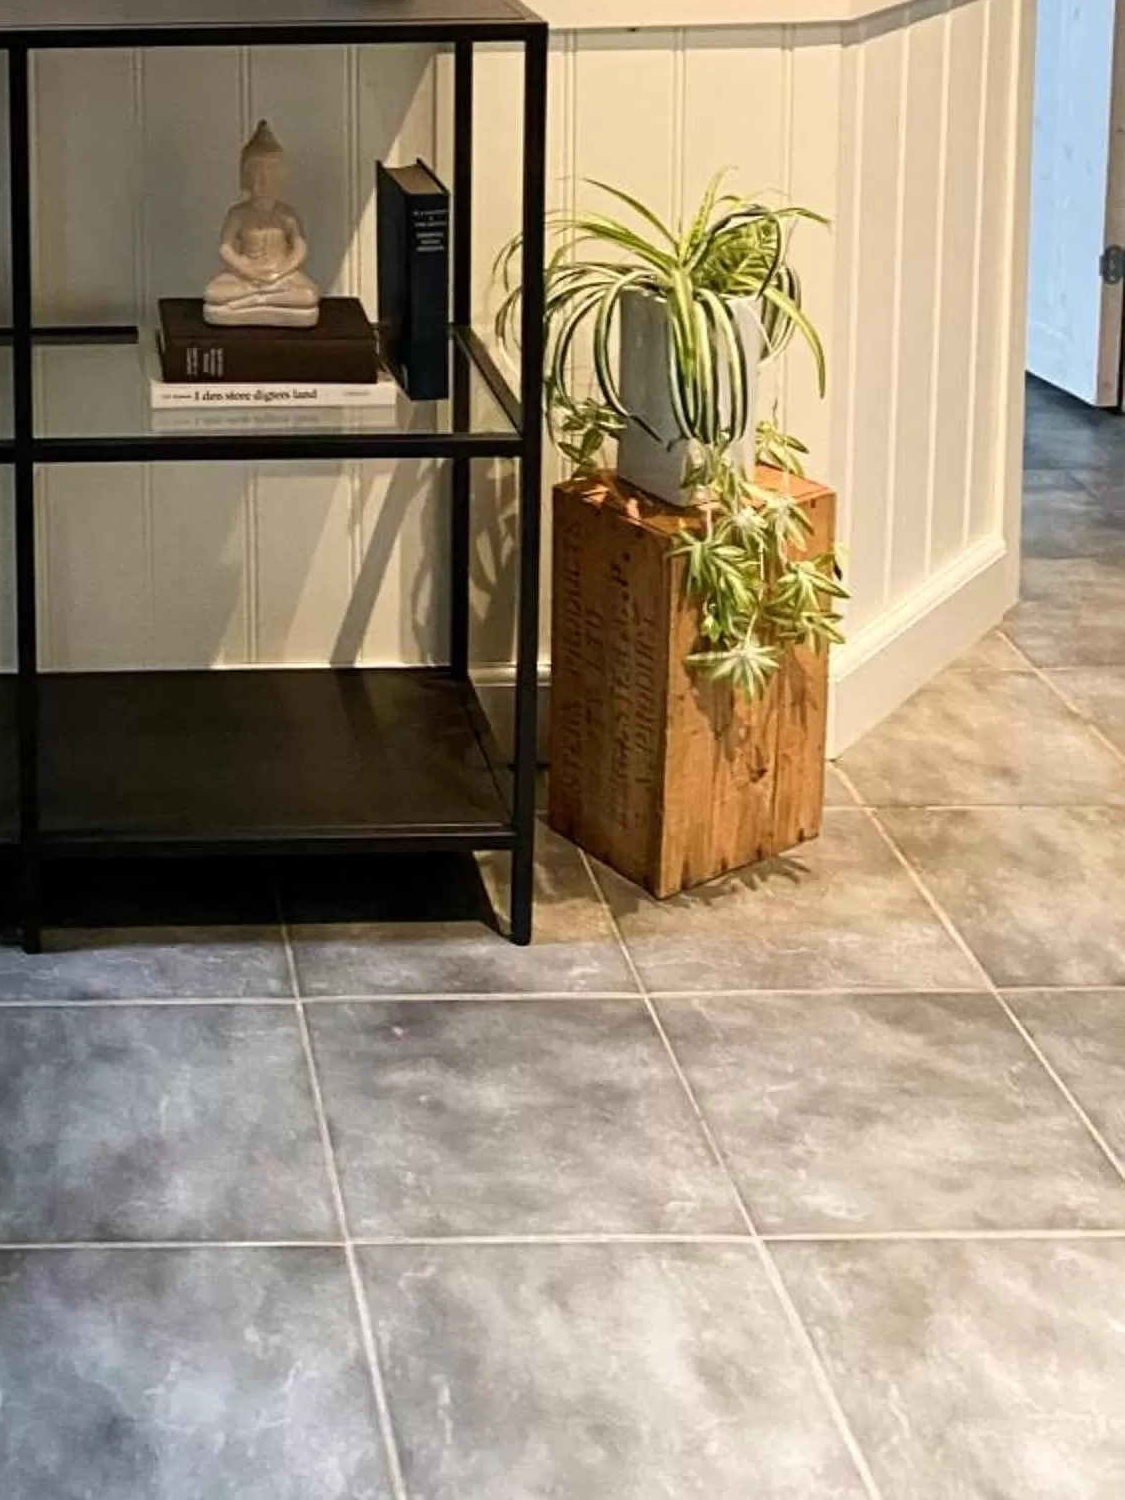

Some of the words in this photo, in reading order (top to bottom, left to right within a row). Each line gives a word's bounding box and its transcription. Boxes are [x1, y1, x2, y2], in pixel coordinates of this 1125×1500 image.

[203, 389, 224, 401] den
[225, 390, 251, 401] store
[292, 387, 318, 400] land
